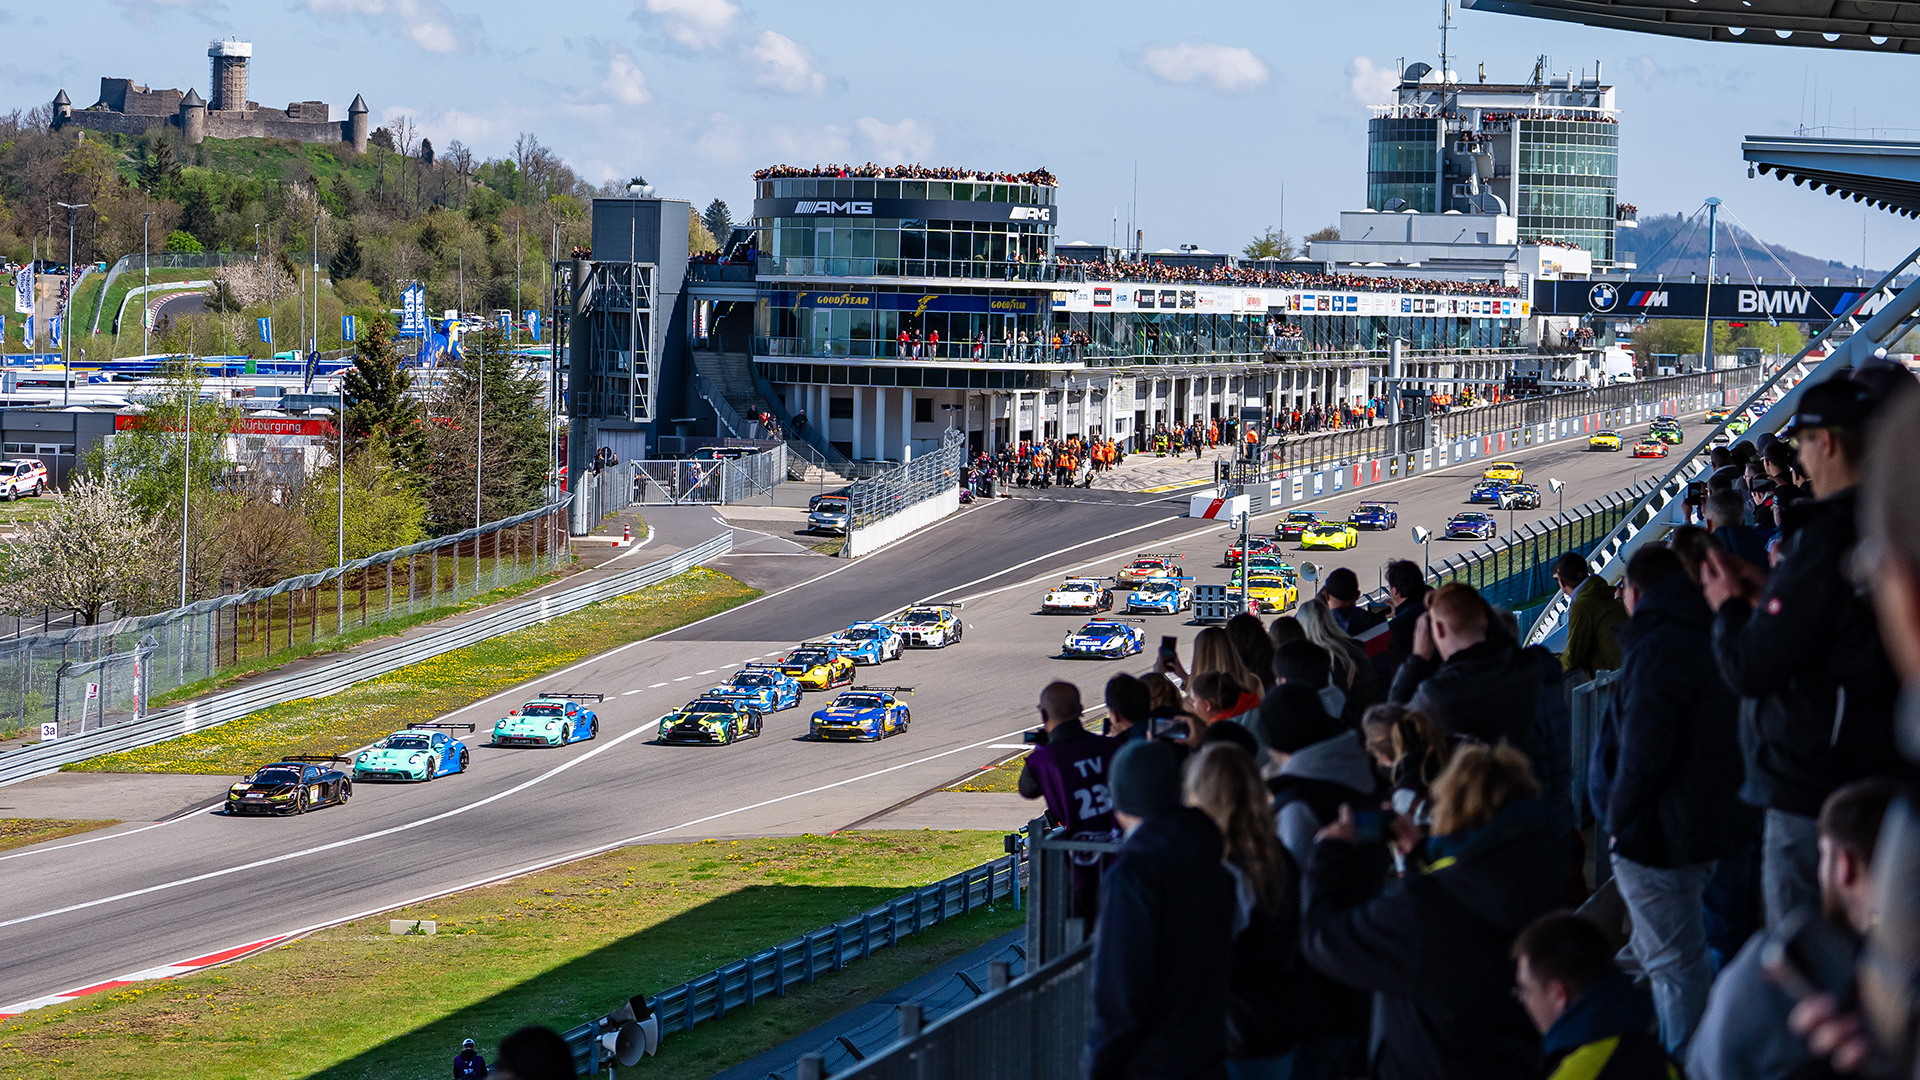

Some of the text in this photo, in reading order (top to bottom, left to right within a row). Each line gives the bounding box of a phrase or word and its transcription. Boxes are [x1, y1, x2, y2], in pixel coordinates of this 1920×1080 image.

[811, 201, 873, 214] AMG
[1025, 207, 1050, 220] AMG
[817, 293, 869, 306] GOODYEAR
[991, 299, 1026, 311] GOODYEAR
[1738, 290, 1811, 314] BMW
[43, 725, 56, 736] 3a
[1074, 756, 1102, 778] TV
[1074, 784, 1113, 820] 23
